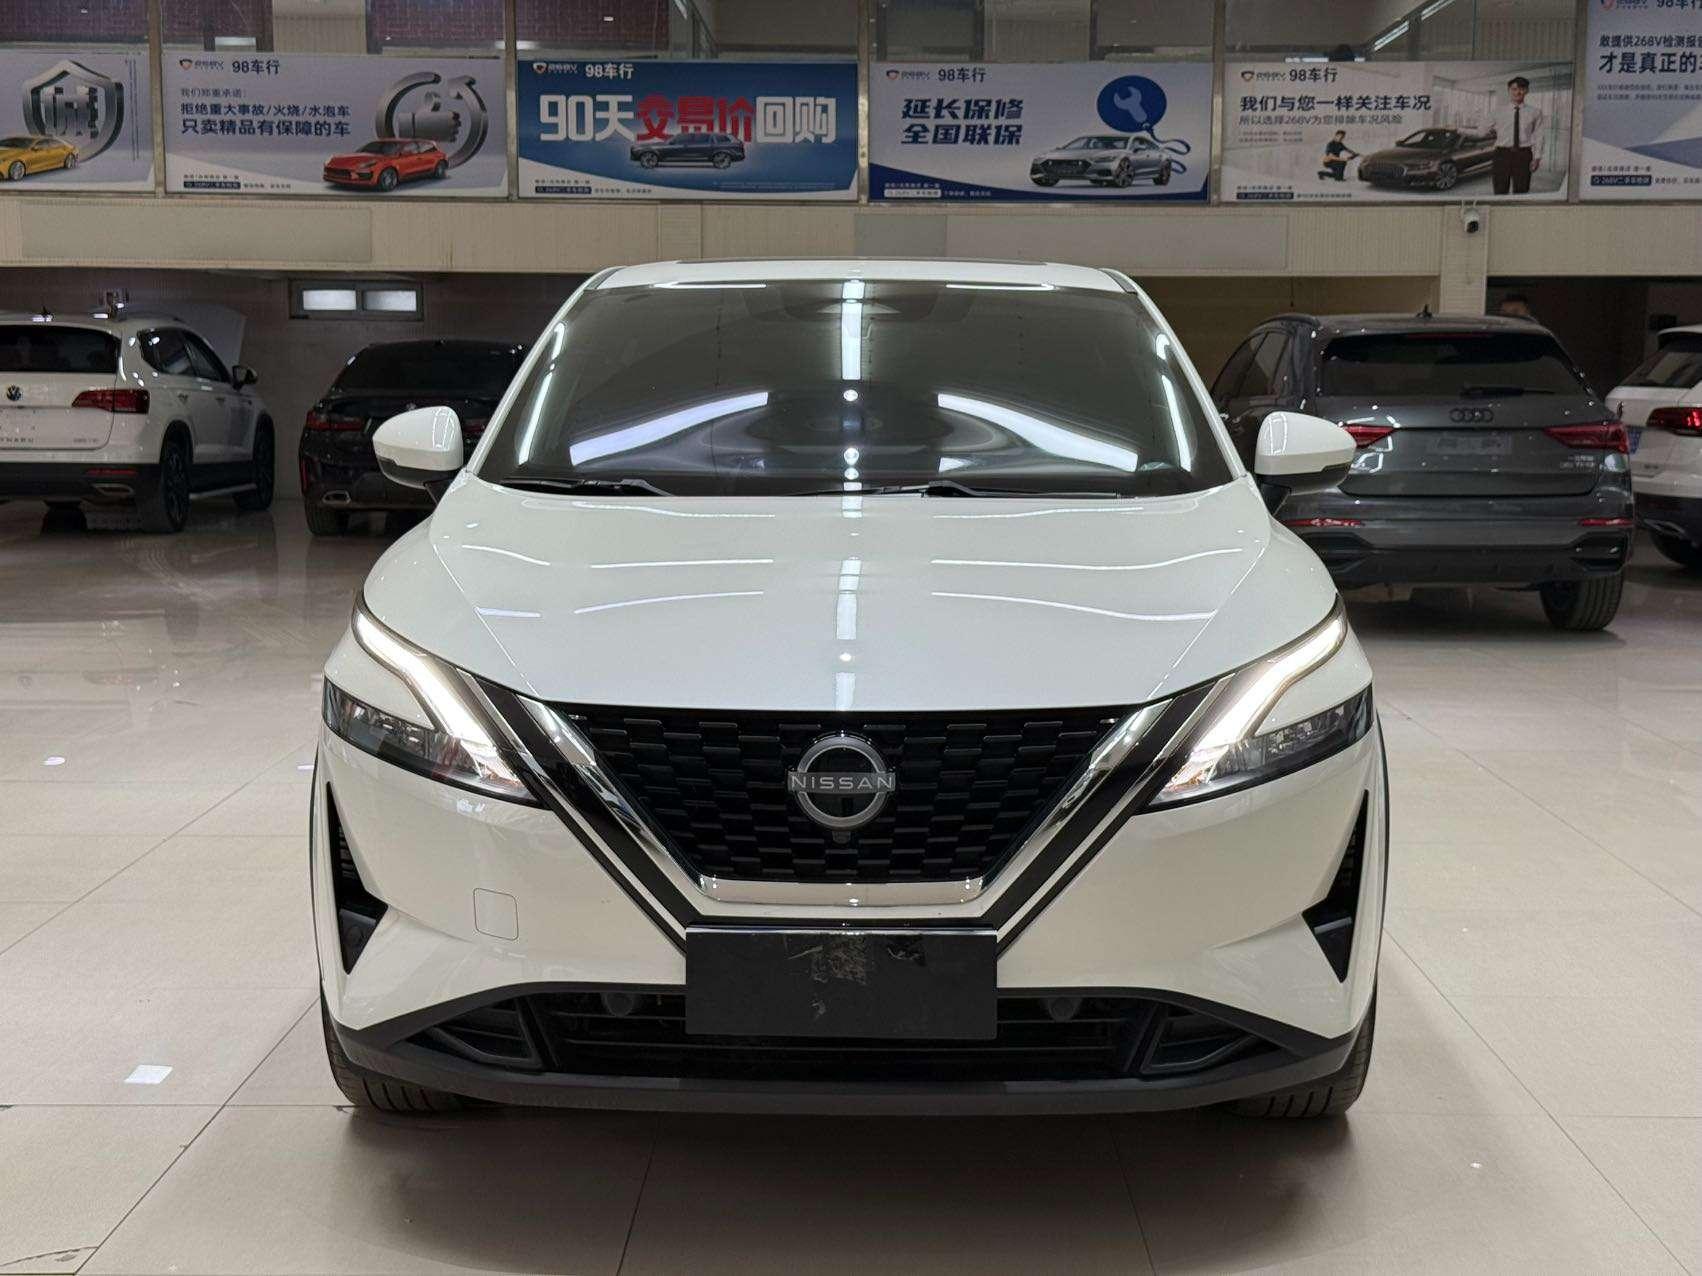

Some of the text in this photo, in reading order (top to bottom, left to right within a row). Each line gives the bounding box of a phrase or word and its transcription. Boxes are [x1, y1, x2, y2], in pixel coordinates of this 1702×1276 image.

[232, 60, 280, 74] 98车行
[585, 63, 634, 79] 98车行
[1599, 52, 1702, 74] 才是真正的
[938, 68, 987, 82] 98车行
[1289, 68, 1338, 82] 98车行
[902, 98, 1024, 119] 延长保修
[1240, 95, 1432, 112] 我们与您一样关注车况
[539, 94, 837, 143] 90天交易价回购
[181, 118, 350, 137] 只卖精品有保障的车
[901, 124, 1022, 145] 全国联保
[792, 776, 893, 789] NISSAN
